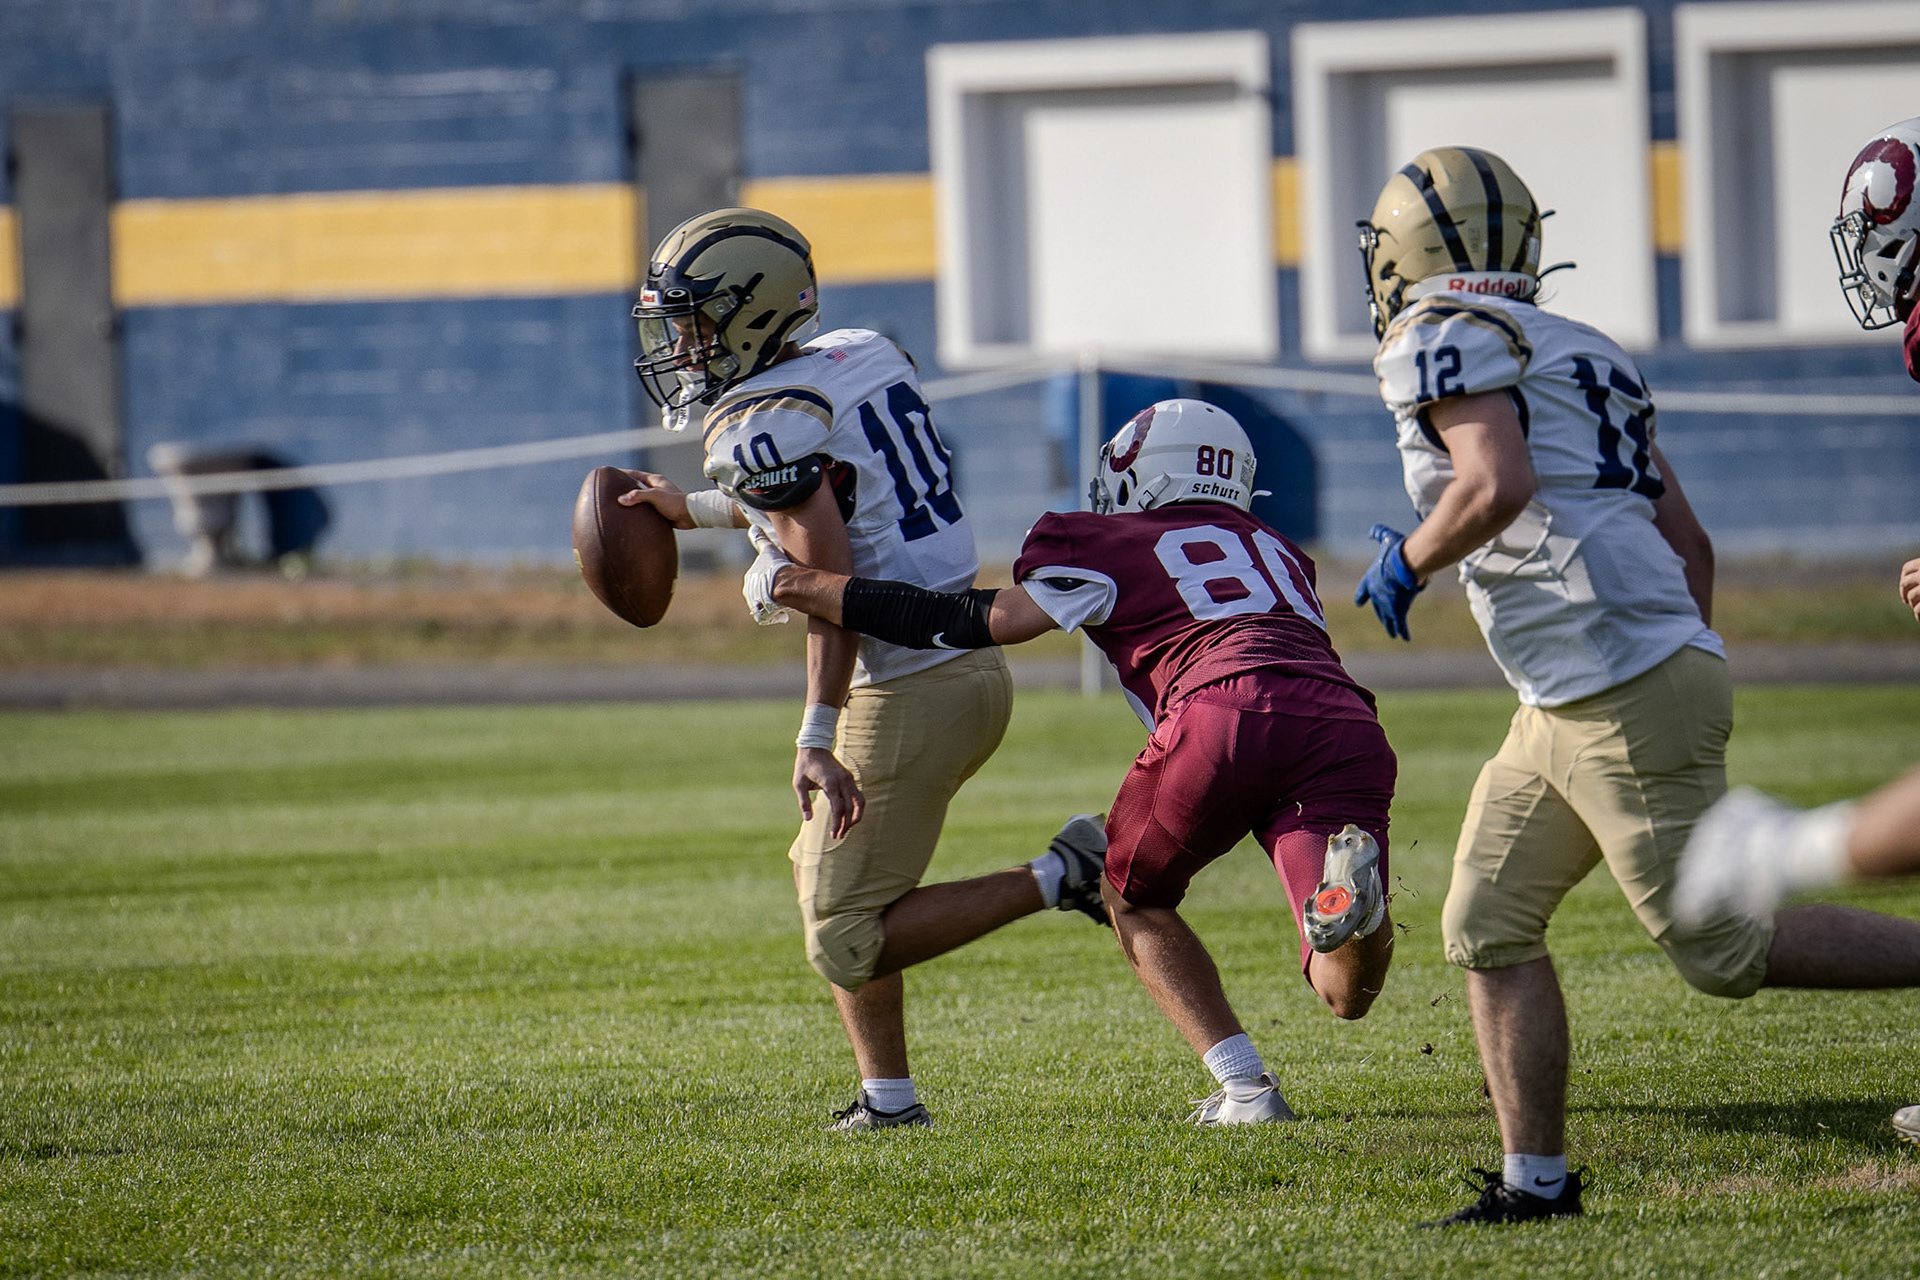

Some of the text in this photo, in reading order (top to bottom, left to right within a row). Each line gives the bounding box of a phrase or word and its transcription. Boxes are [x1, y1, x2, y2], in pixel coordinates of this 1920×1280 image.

[1415, 345, 1465, 403] 12
[733, 432, 784, 475] 10
[857, 381, 963, 542] 10
[1196, 444, 1234, 480] 80
[1570, 357, 1665, 499] 12
[1153, 524, 1327, 632] 80
